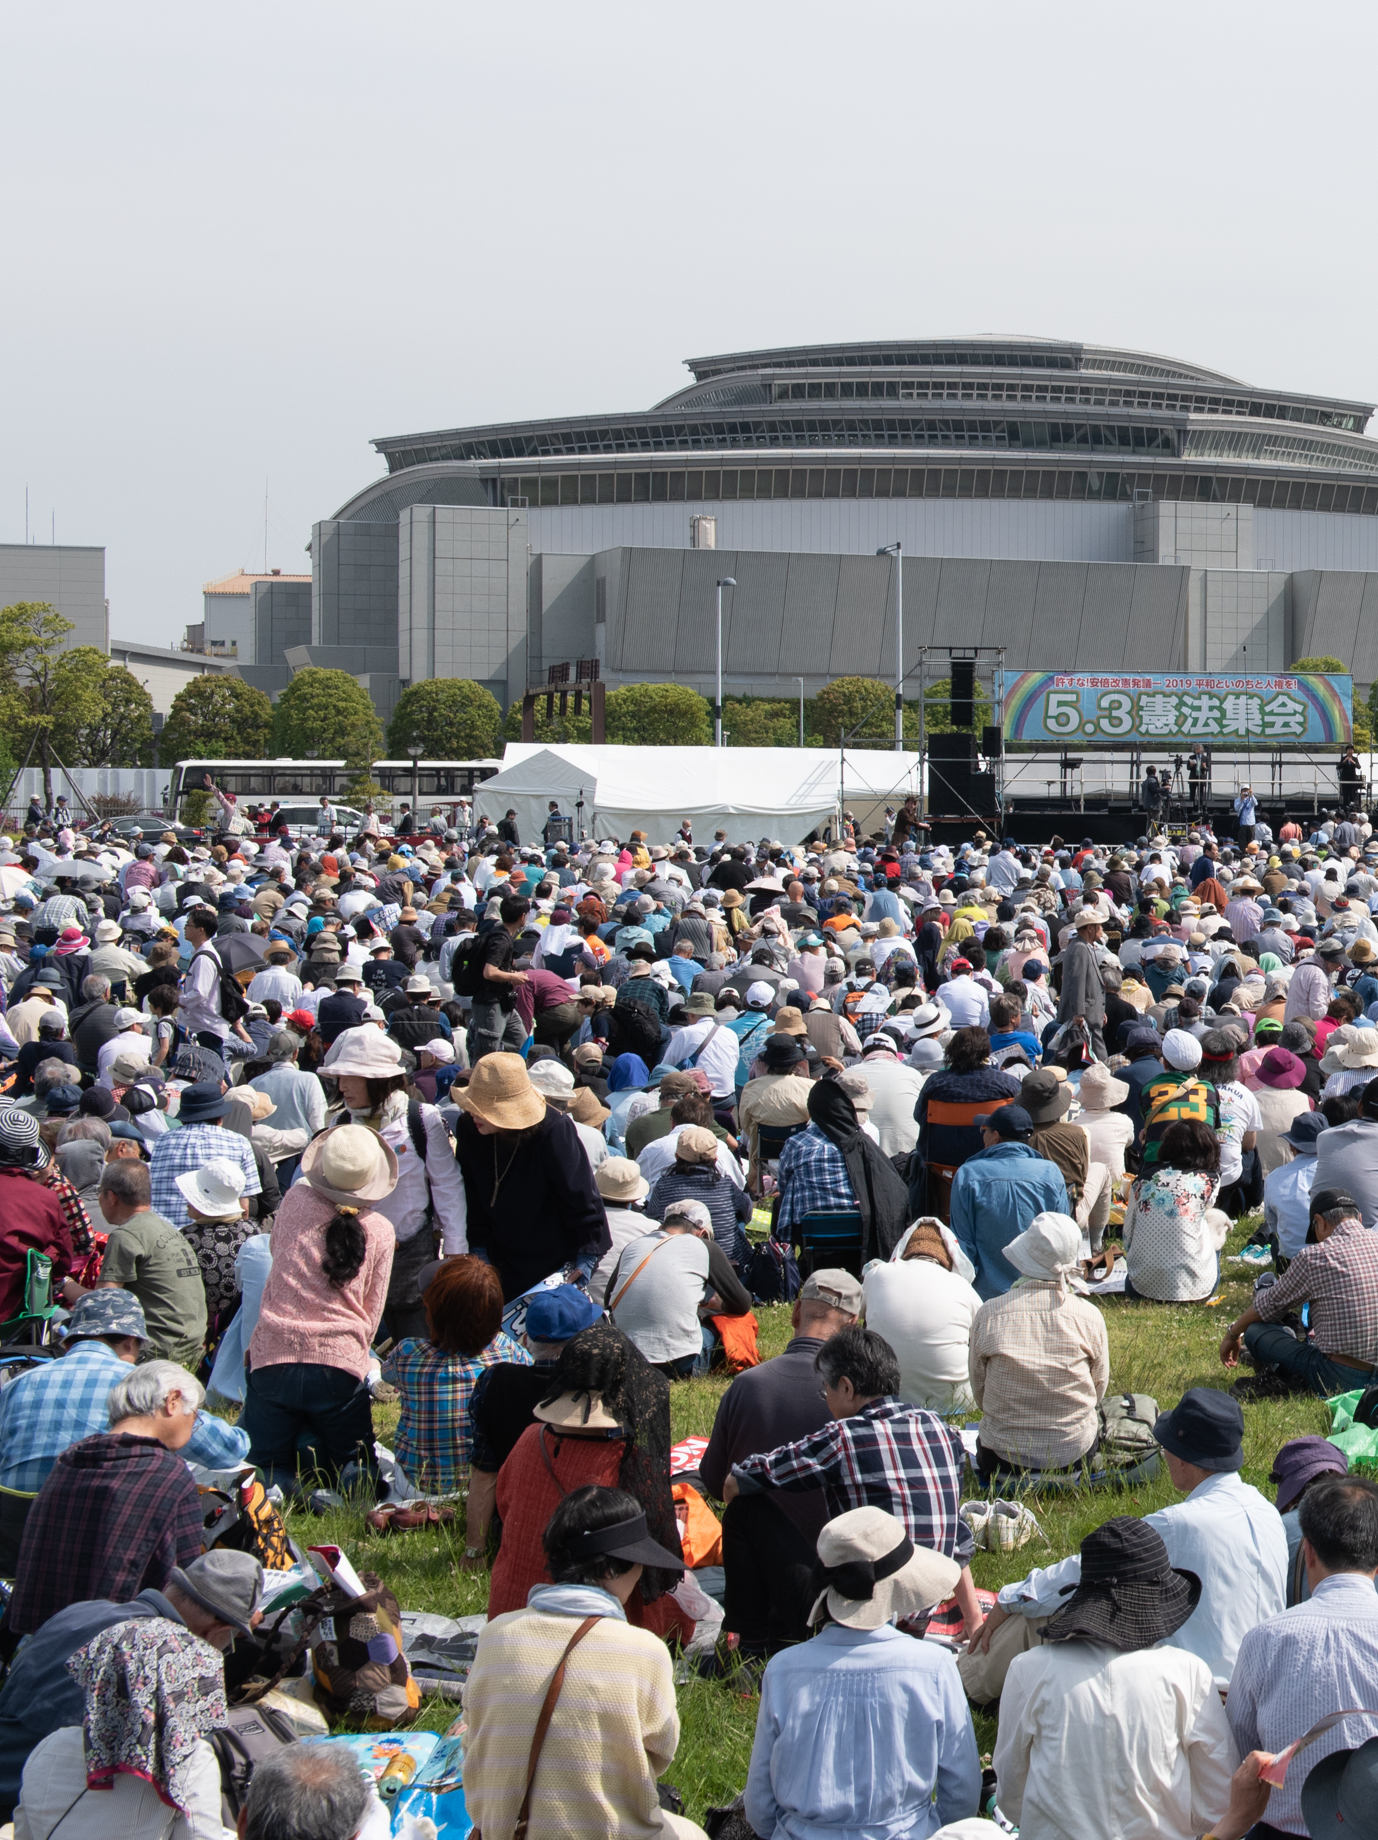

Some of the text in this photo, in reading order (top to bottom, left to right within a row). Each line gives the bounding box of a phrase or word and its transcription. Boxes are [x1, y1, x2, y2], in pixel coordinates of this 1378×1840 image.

[1165, 678, 1192, 689] 2019
[1195, 679, 1297, 690] 平和といのちと人権を!
[1046, 693, 1304, 735] 5.3憲法集会
[1149, 1083, 1208, 1124] 23
